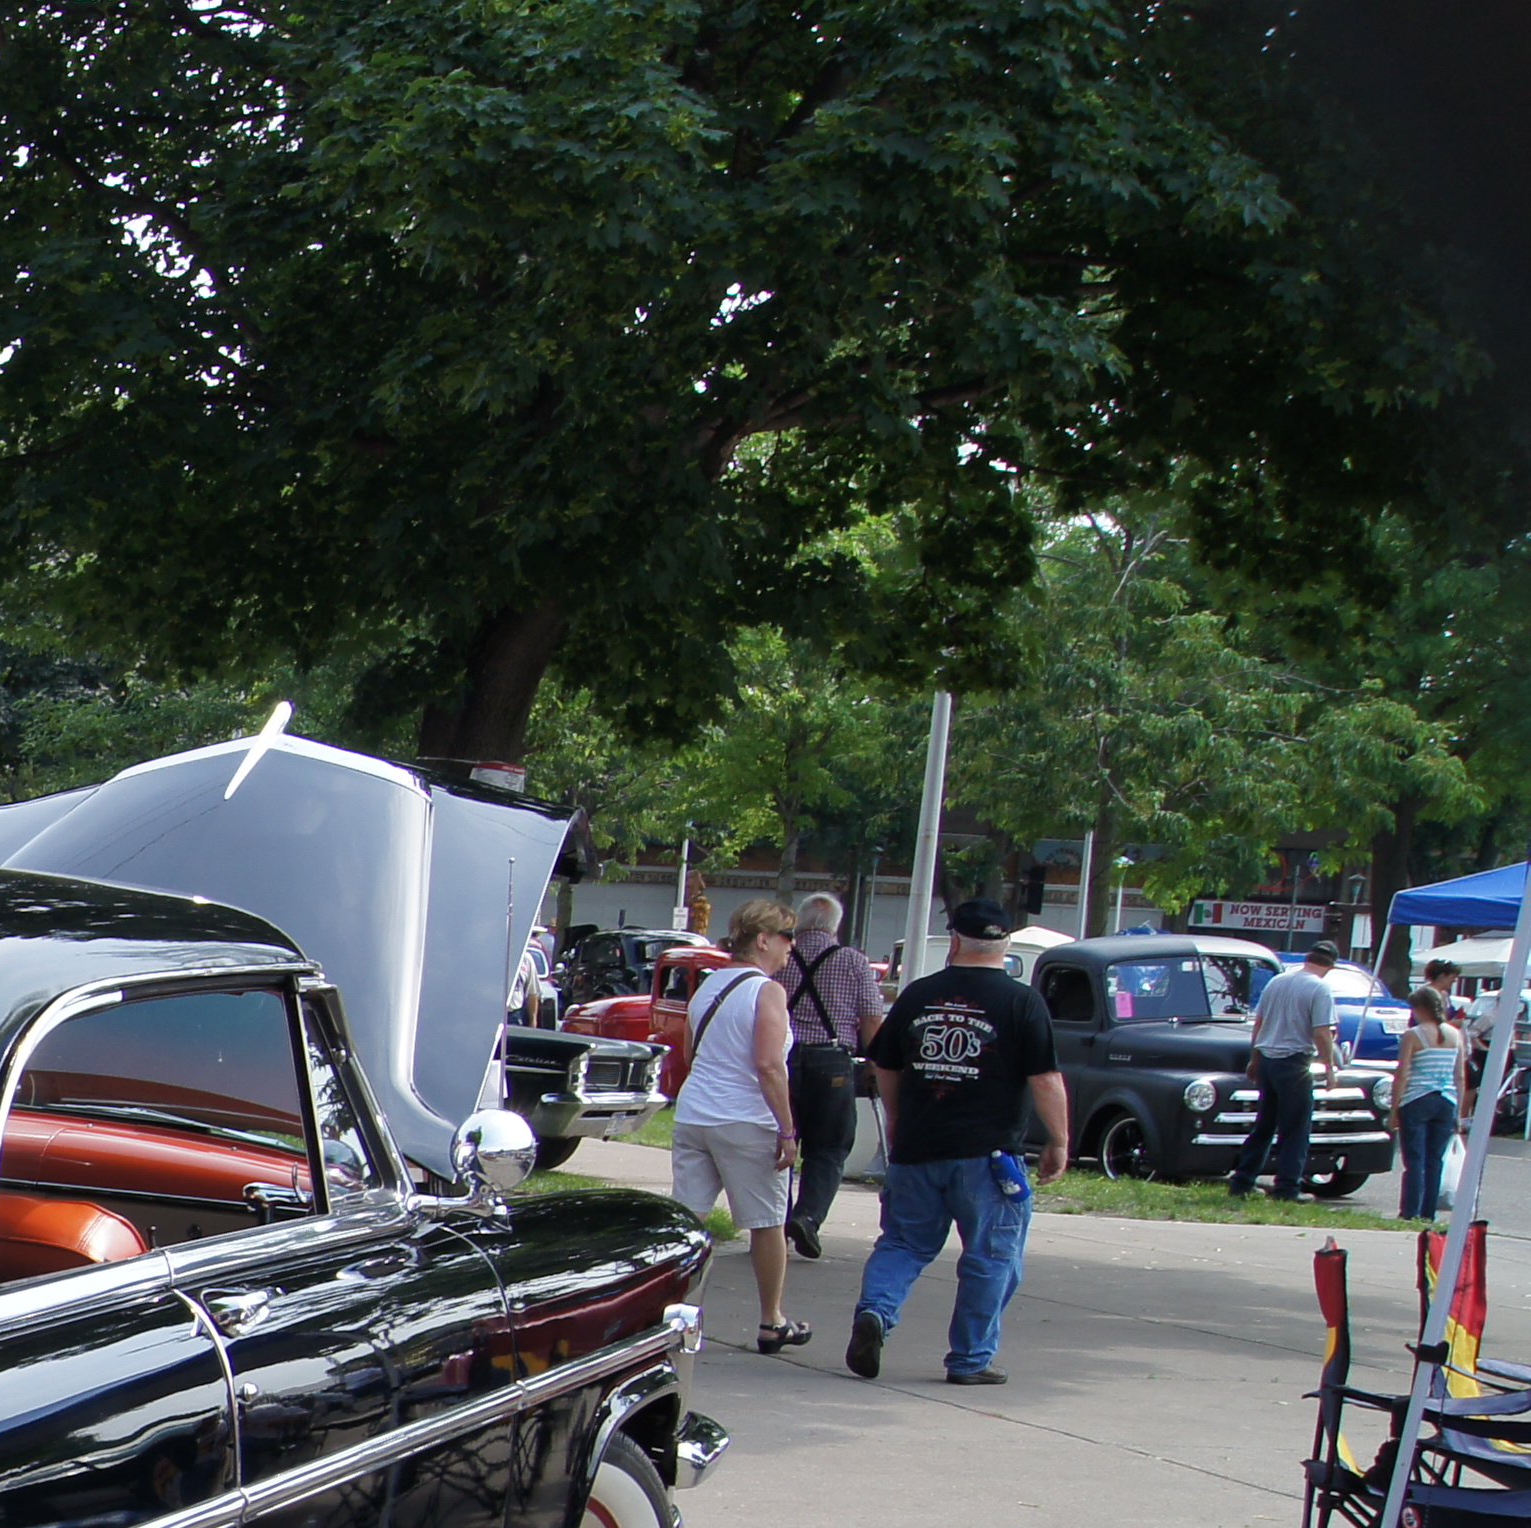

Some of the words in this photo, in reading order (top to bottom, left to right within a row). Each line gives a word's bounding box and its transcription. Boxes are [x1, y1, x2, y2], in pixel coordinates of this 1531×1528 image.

[1230, 904, 1262, 915] NOW
[913, 1013, 945, 1027] BACK
[947, 1013, 966, 1023] TO
[967, 1016, 994, 1034] THE
[920, 1025, 981, 1062] 50's
[912, 1062, 979, 1075] WEEKEND
